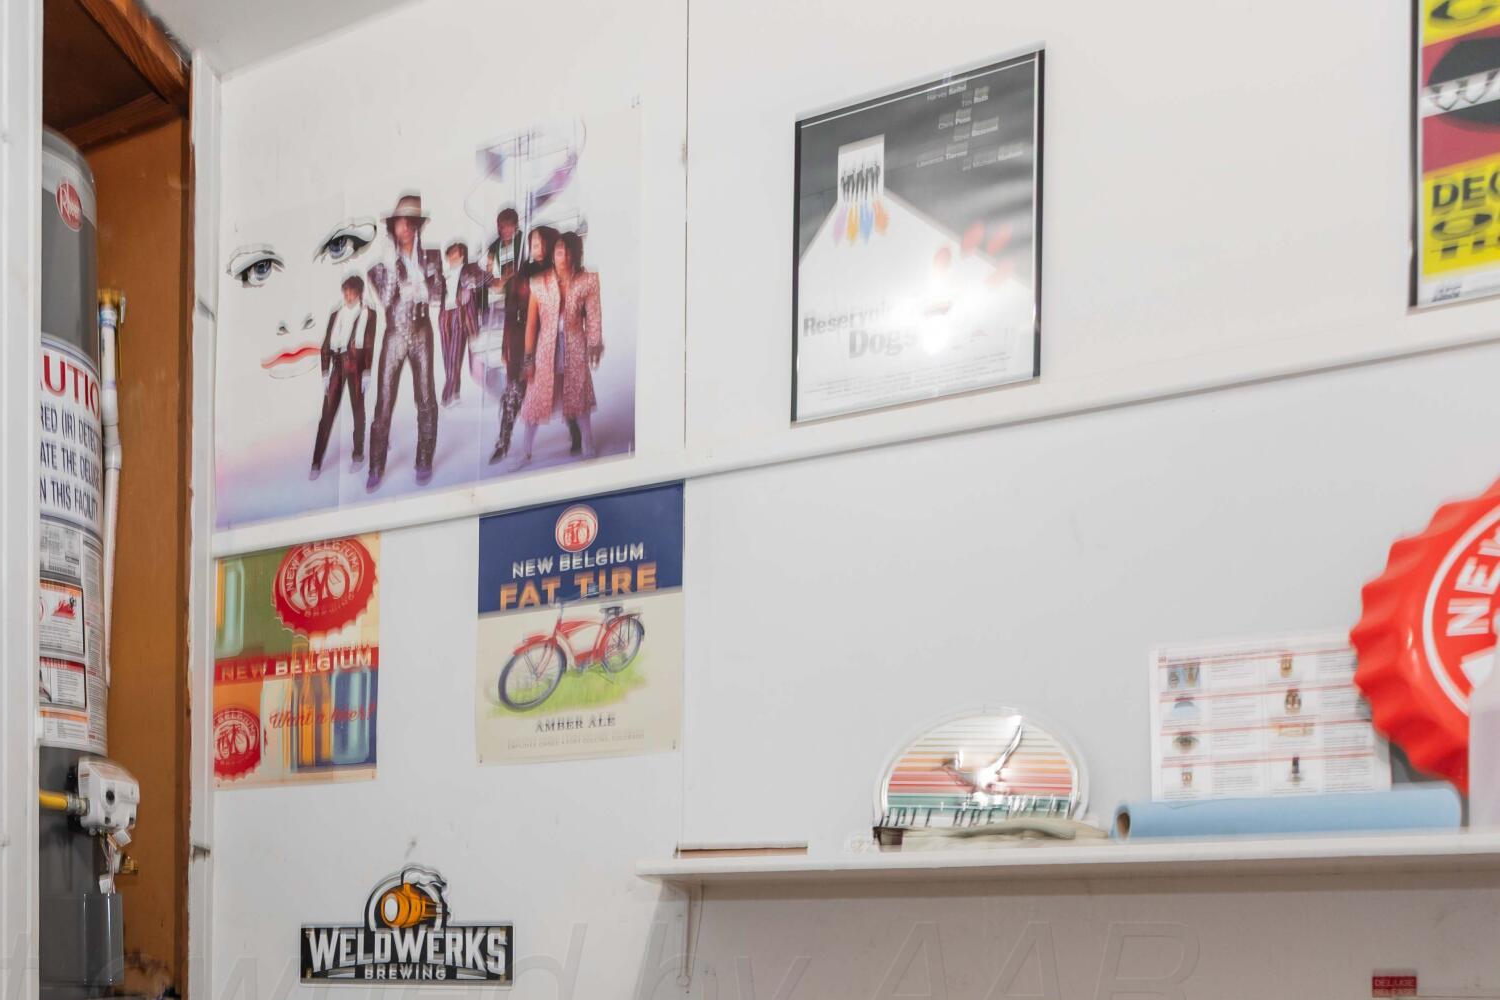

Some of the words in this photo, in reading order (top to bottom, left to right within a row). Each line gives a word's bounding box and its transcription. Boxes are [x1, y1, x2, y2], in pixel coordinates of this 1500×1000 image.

[803, 299, 893, 338] Reservoi
[849, 327, 917, 360] Dogs
[42, 354, 100, 421] UTIO
[61, 444, 77, 477] THE
[51, 481, 72, 510] THIS
[512, 558, 553, 580] NEW
[559, 545, 645, 572] BELGIUM
[500, 578, 561, 610] FAT
[574, 563, 657, 597] TIRE
[222, 660, 267, 682] NEW
[276, 649, 372, 678] BELGIUM
[535, 717, 584, 733] AMBER
[588, 713, 617, 729] ALE
[308, 926, 508, 974] WELDWERKS
[364, 967, 447, 980] BREWING
